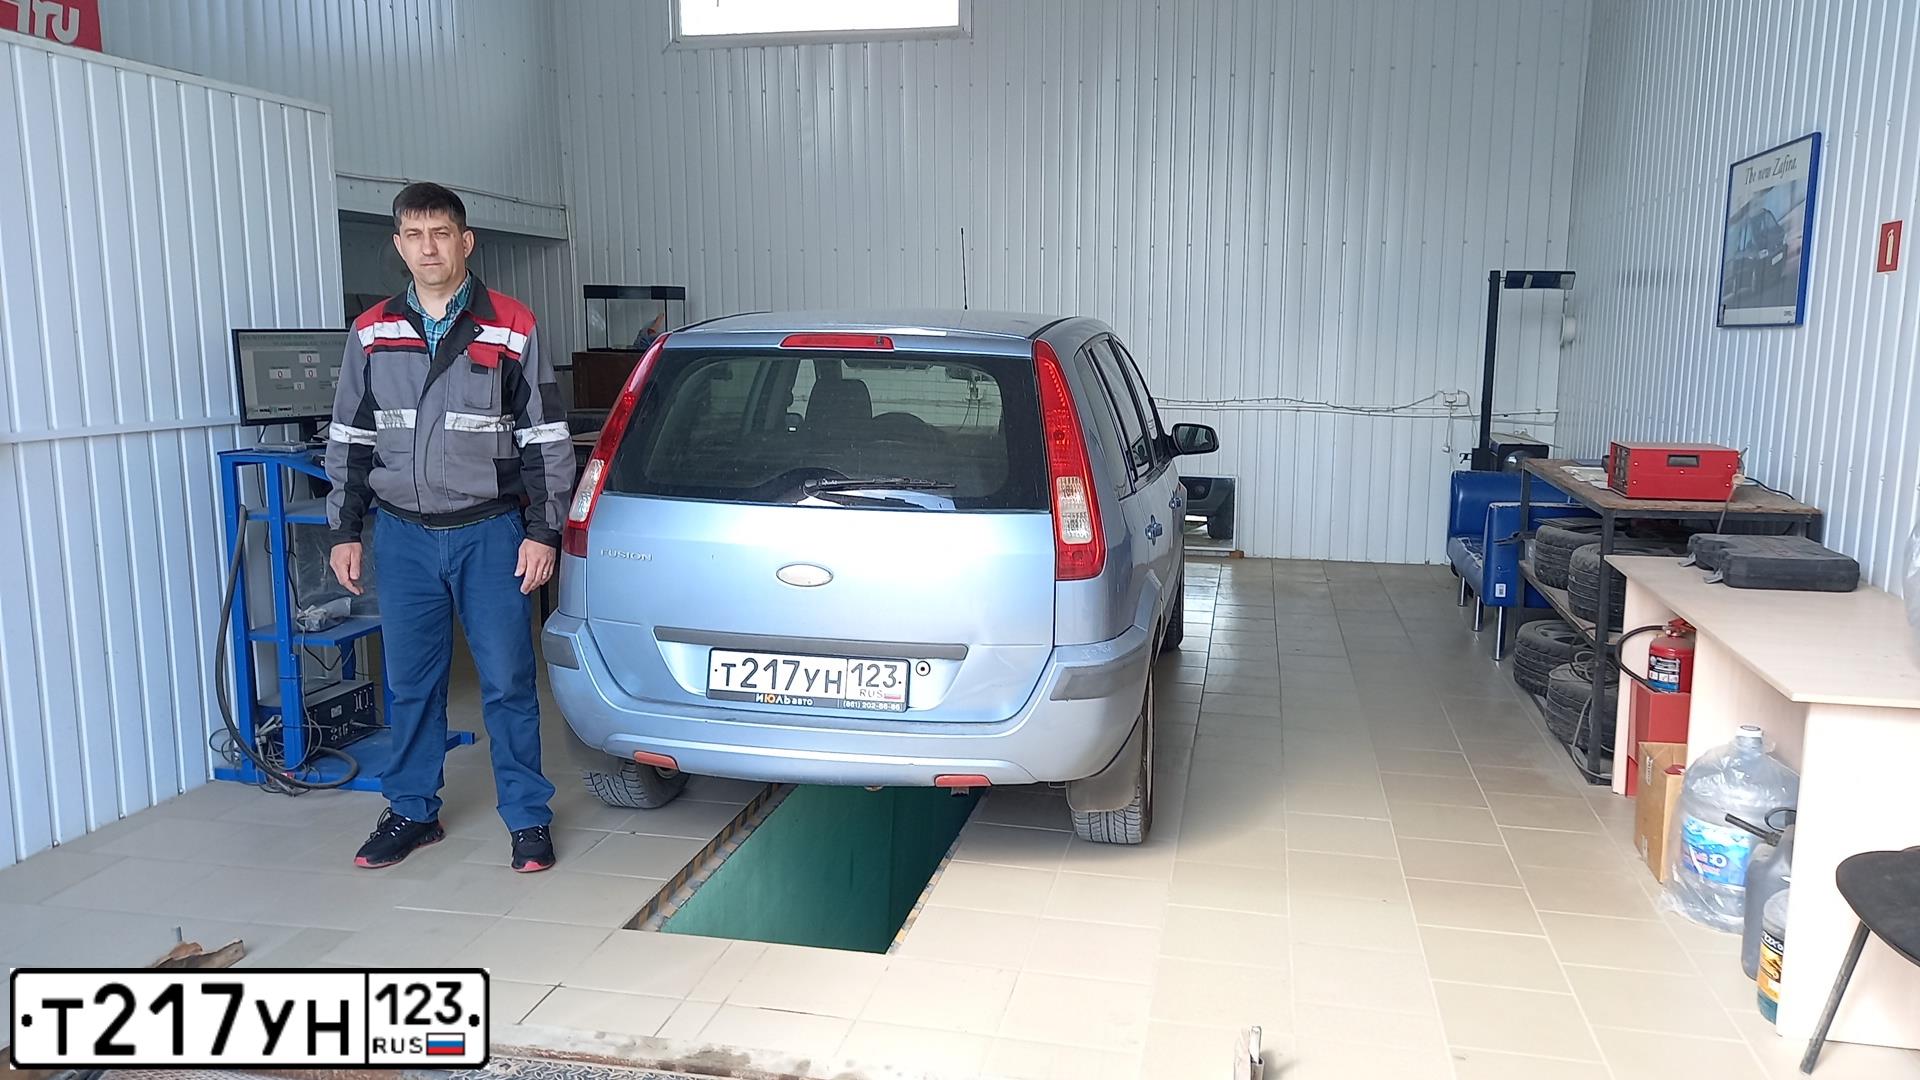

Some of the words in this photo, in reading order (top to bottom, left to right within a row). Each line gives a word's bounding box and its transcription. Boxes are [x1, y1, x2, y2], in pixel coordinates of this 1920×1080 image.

[1745, 166, 1757, 185] The
[1757, 167, 1772, 180] new
[600, 548, 654, 561] FUSION
[850, 662, 898, 688] 123
[859, 689, 883, 698] RUS
